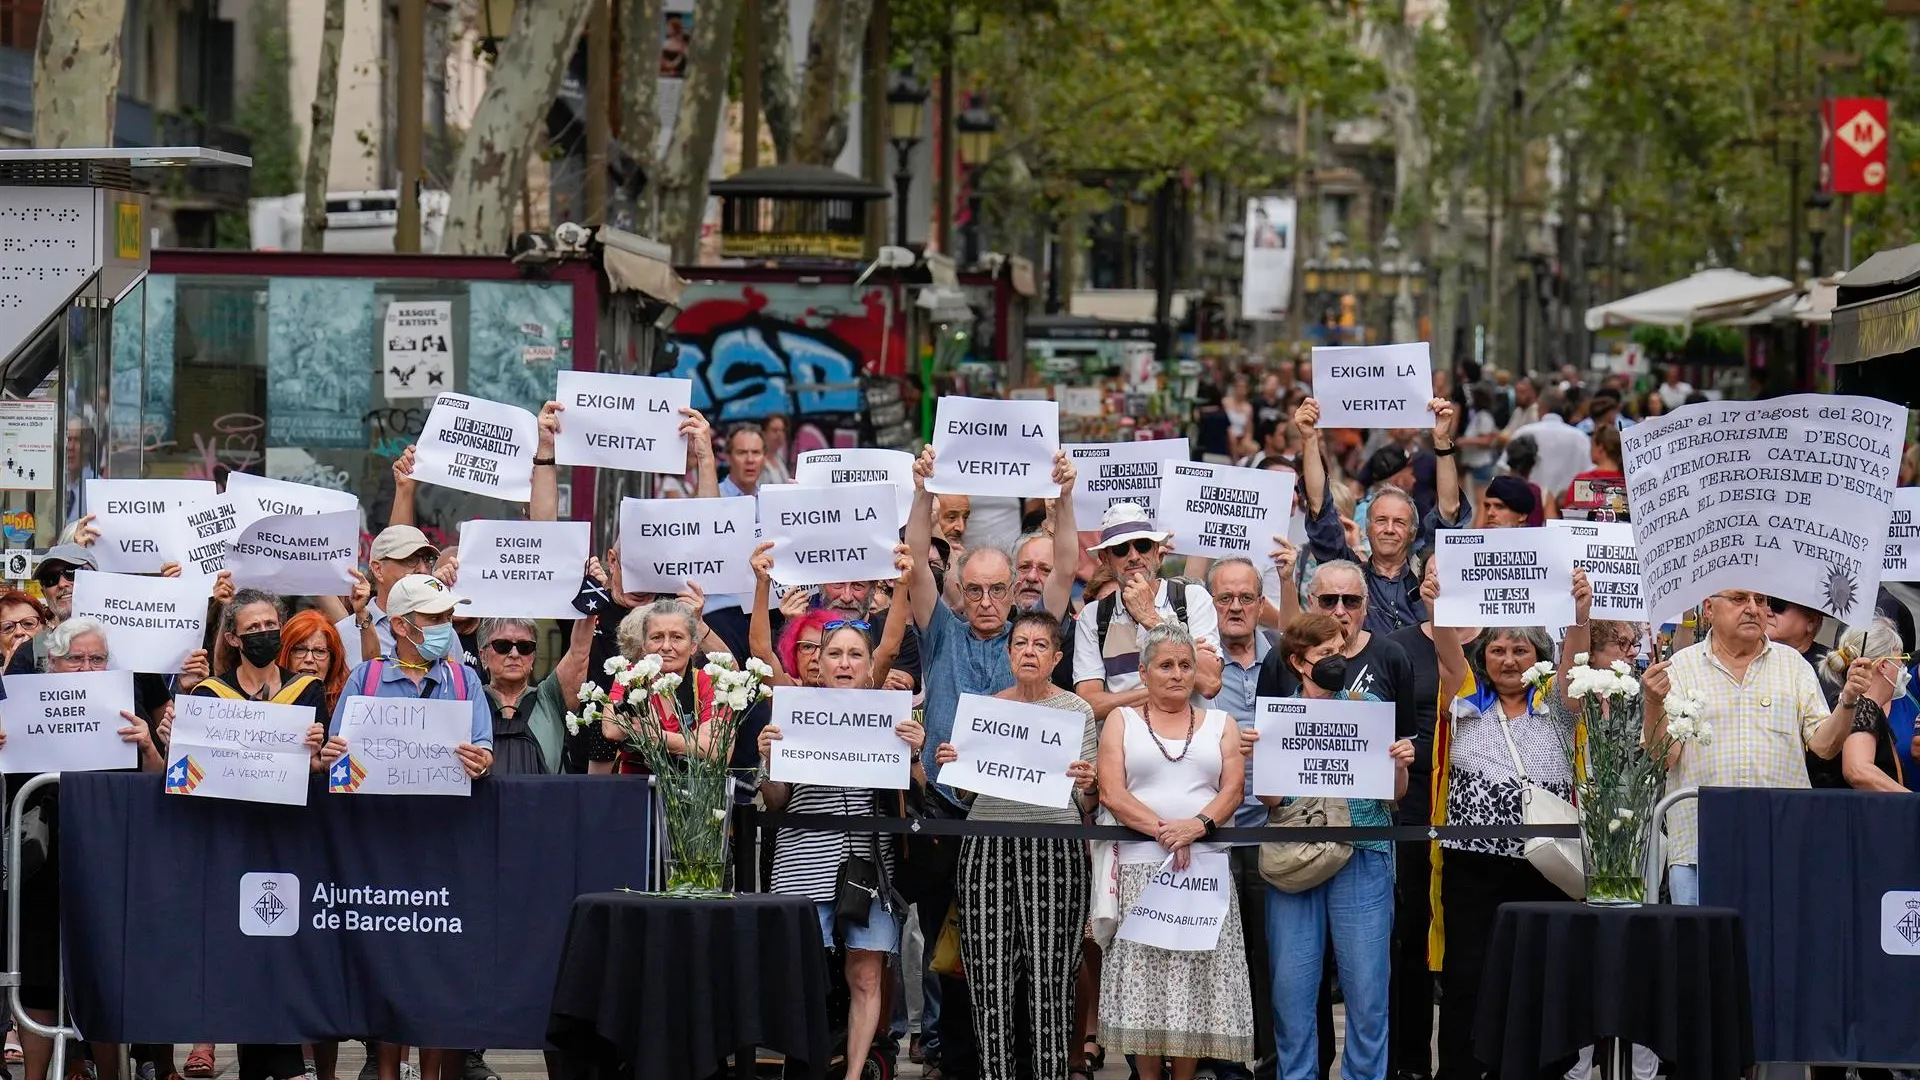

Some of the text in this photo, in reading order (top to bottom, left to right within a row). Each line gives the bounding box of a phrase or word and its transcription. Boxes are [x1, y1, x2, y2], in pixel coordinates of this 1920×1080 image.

[1854, 123, 1873, 141] M
[1330, 363, 1417, 379] EXIGIM LA
[574, 392, 671, 414] EXIGIM LA
[1341, 398, 1408, 412] VERITAT
[454, 417, 511, 440] WE DEMAND
[947, 420, 1045, 439] EXIGIM LA
[1624, 406, 1895, 454] Va passar el 17 d'agost del 2017.
[438, 428, 521, 458] RESPONSABILITY
[584, 430, 657, 452] VERITAT
[1627, 427, 1892, 476] ¿FOU TERRORISME D'ESCOLA
[454, 452, 497, 472] WE ASK
[956, 459, 1032, 478] VERITAT
[1101, 462, 1157, 477] WE DEMAND
[446, 464, 501, 488] THE TRUTH
[832, 469, 889, 483] WE DEMAND
[1176, 467, 1213, 477] 17 D'AGOST
[1631, 448, 1891, 502] PER ATEMORIR CATALUNYA?
[1087, 477, 1163, 491] RESPONSABILIT
[1657, 484, 1691, 508] SER
[1699, 467, 1823, 491] TERRORISME
[1825, 473, 1894, 505] D'ESTAT
[1201, 486, 1258, 504] WE DEMAND
[1696, 493, 1716, 514] EL
[1718, 488, 1778, 504] DESIG
[1784, 489, 1813, 507] DE
[107, 500, 166, 515] EXIGIM
[187, 503, 237, 527] THE TRUTH
[1186, 499, 1268, 520] RESPONSABILITY
[780, 507, 877, 526] EXIGIM LA
[198, 517, 236, 538] WE ASK
[641, 521, 735, 536] EXIGIM LA
[1206, 522, 1246, 537] WE ASK
[1768, 515, 1870, 553] CATALANS?
[257, 531, 329, 546] RECLAMEM
[495, 536, 543, 549] EXIGIM
[1198, 534, 1251, 551] THE TRUTH
[1446, 535, 1483, 543] 17 D'AGOST
[233, 543, 352, 561] RESPONSABILITATS
[499, 552, 541, 564] SABER
[794, 547, 868, 564] VERITAT
[1475, 551, 1536, 566] WE DEMAND
[1588, 545, 1604, 559] WE
[1691, 534, 1745, 564] SABER
[1754, 534, 1782, 551] LA
[1793, 539, 1863, 575] VERITAT
[481, 568, 555, 581] LA VERITAT
[653, 561, 725, 575] VERITAT
[1461, 567, 1548, 581] RESPONSABILITY
[1656, 577, 1682, 602] TOT
[1690, 552, 1759, 584] PLEGAT!
[1486, 588, 1527, 600] WE ASK
[1595, 582, 1638, 595] WE ASK
[104, 598, 176, 613] RECLAMEM
[1479, 602, 1535, 615] THE TRUTH
[1591, 596, 1607, 608] HE
[1610, 596, 1644, 609] TRUTH
[39, 689, 87, 701] EXIGIM
[44, 706, 86, 718] SABER
[185, 701, 266, 721] No t'oblidem
[349, 701, 426, 730] EXIGIM
[1269, 704, 1305, 713] 17 D'AGOST
[791, 711, 893, 728] RECLAMEM
[27, 721, 101, 735] LA VERITAT
[971, 718, 1061, 746] EXIGIM LA
[1297, 722, 1357, 737] WE DEMAND
[205, 725, 299, 749] XAVIER MARTÍNEZ
[1281, 737, 1369, 752] RESPONSABILITY
[211, 748, 275, 763] VOLEM SABER
[781, 749, 900, 763] RESPONSABILITATS
[976, 760, 1046, 784] VERITAT
[1305, 759, 1348, 771] WE ASK
[222, 767, 235, 778] LA
[239, 769, 275, 780] VERITAT
[1298, 773, 1354, 786] THE TRUTH
[312, 882, 449, 907] Ajuntament
[312, 910, 462, 933] de Barcelona
[1131, 906, 1218, 926] ESPONSABILITATS
